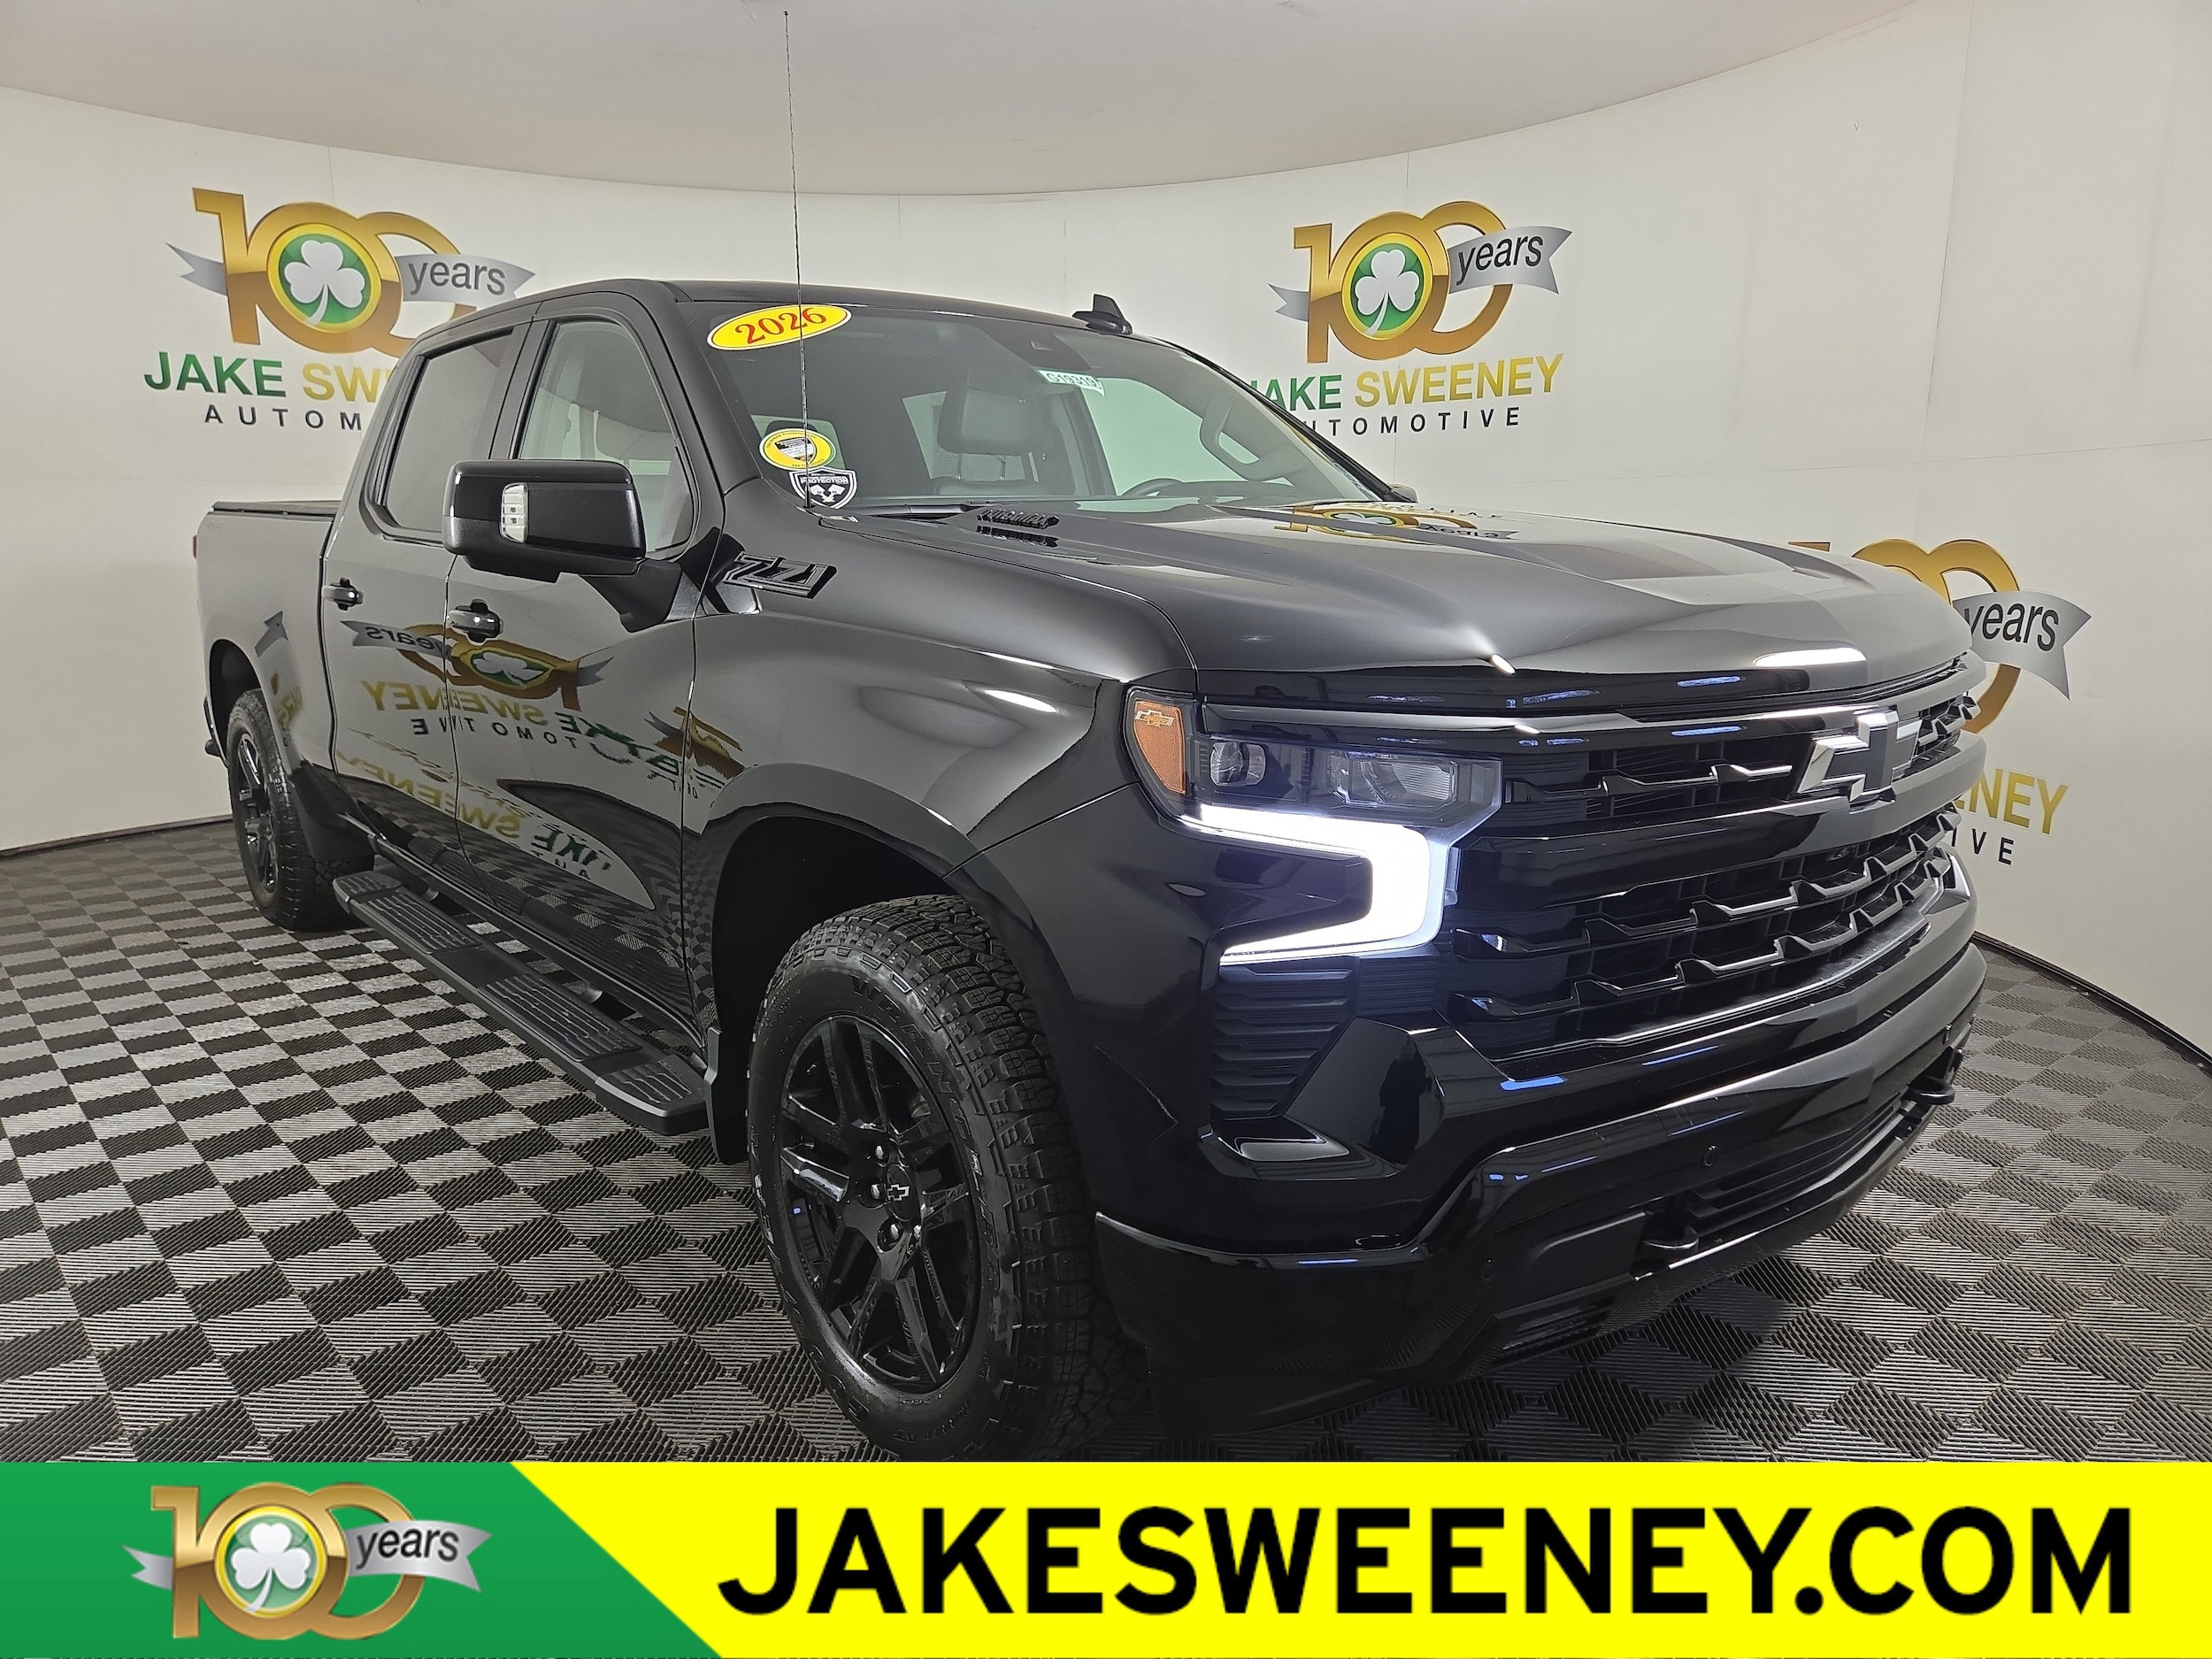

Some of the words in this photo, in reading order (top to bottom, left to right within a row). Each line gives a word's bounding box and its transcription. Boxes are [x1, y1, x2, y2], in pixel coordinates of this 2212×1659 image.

[408, 259, 506, 296] years
[1456, 234, 1543, 285] years
[734, 307, 827, 344] 2026
[143, 350, 288, 398] JAKE
[1355, 353, 1564, 409] SWEENEY
